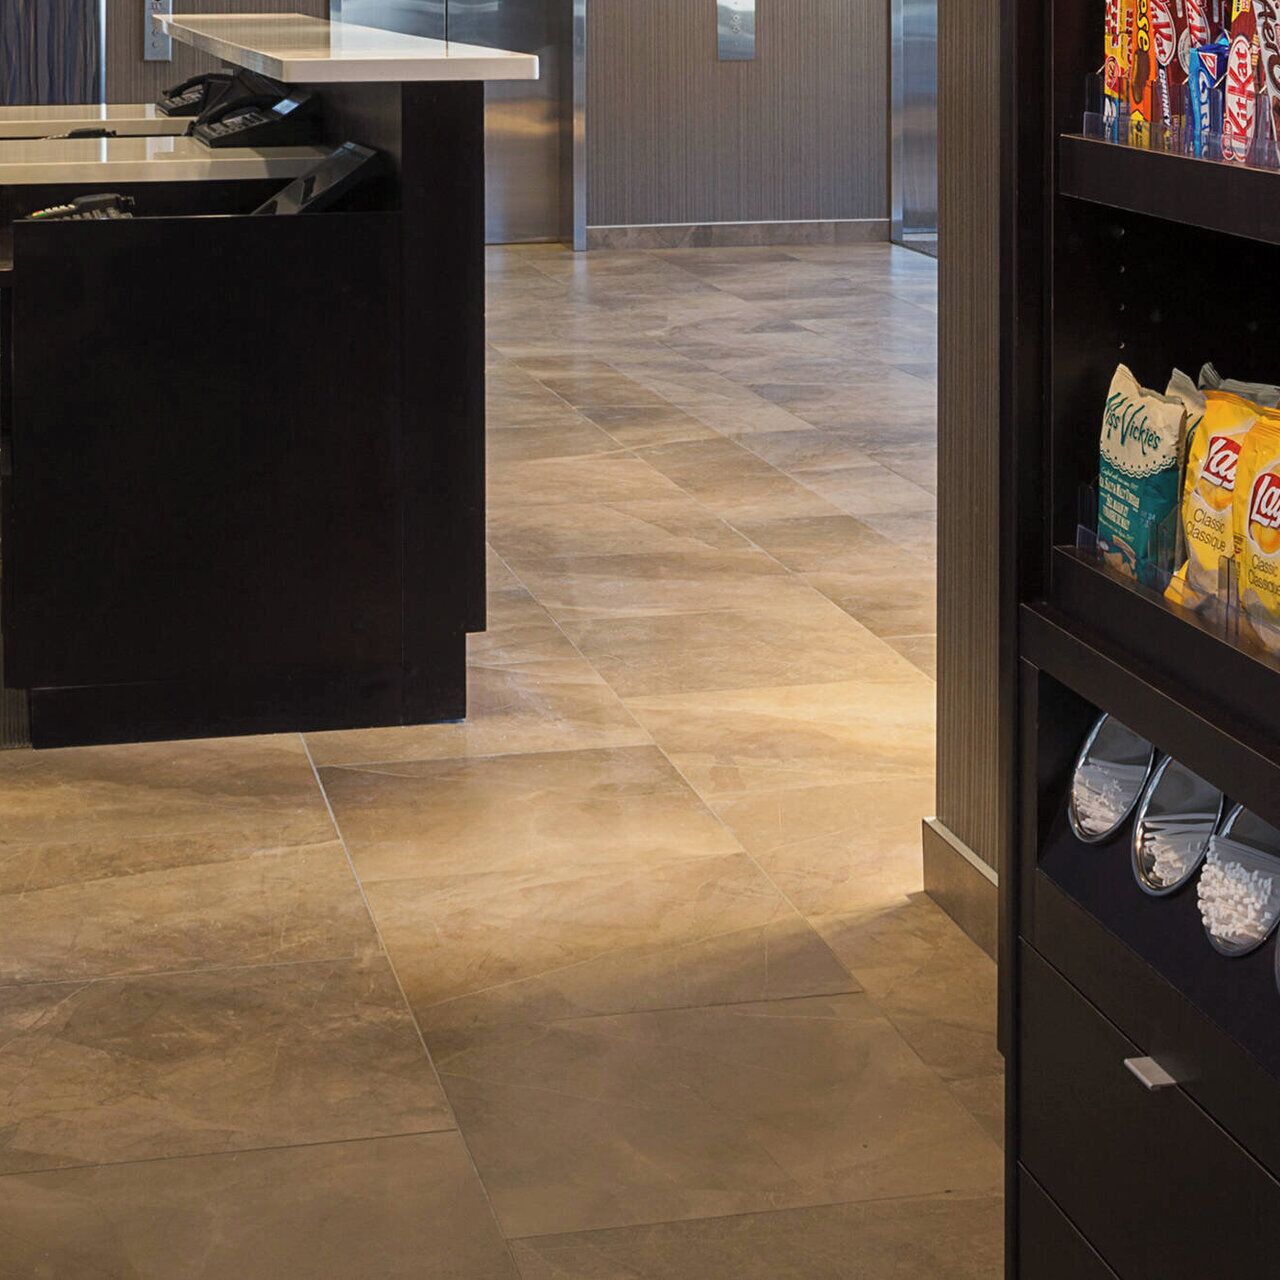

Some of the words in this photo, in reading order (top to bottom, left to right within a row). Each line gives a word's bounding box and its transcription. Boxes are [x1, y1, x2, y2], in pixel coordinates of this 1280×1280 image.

[1158, 67, 1171, 128] CHUNKY
[1227, 49, 1255, 143] KitKat
[1119, 404, 1161, 456] Vickie's
[1185, 520, 1227, 552] Classique
[1193, 507, 1226, 534] Classic
[1251, 553, 1279, 578] Classic
